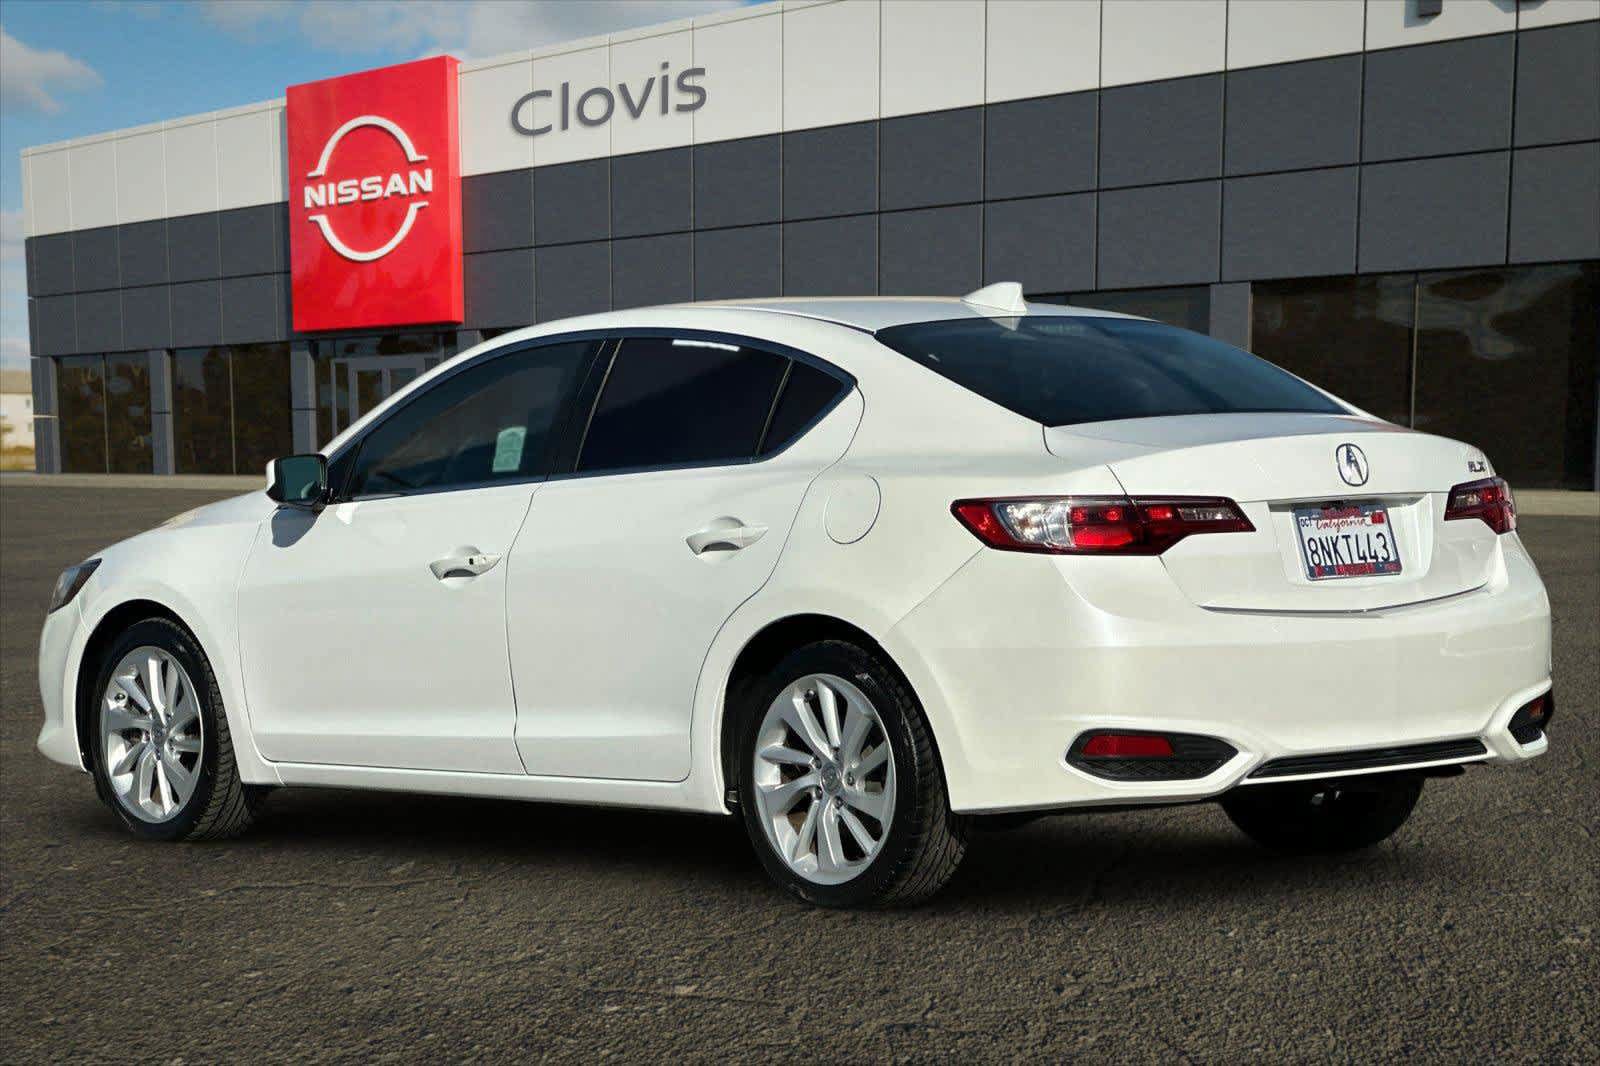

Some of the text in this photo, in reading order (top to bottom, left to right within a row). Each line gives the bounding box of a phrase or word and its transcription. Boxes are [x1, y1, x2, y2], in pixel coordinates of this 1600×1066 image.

[511, 62, 707, 136] Clovis
[303, 168, 433, 208] NISSAN
[1316, 516, 1369, 532] California
[1307, 532, 1390, 565] 8NKT443
